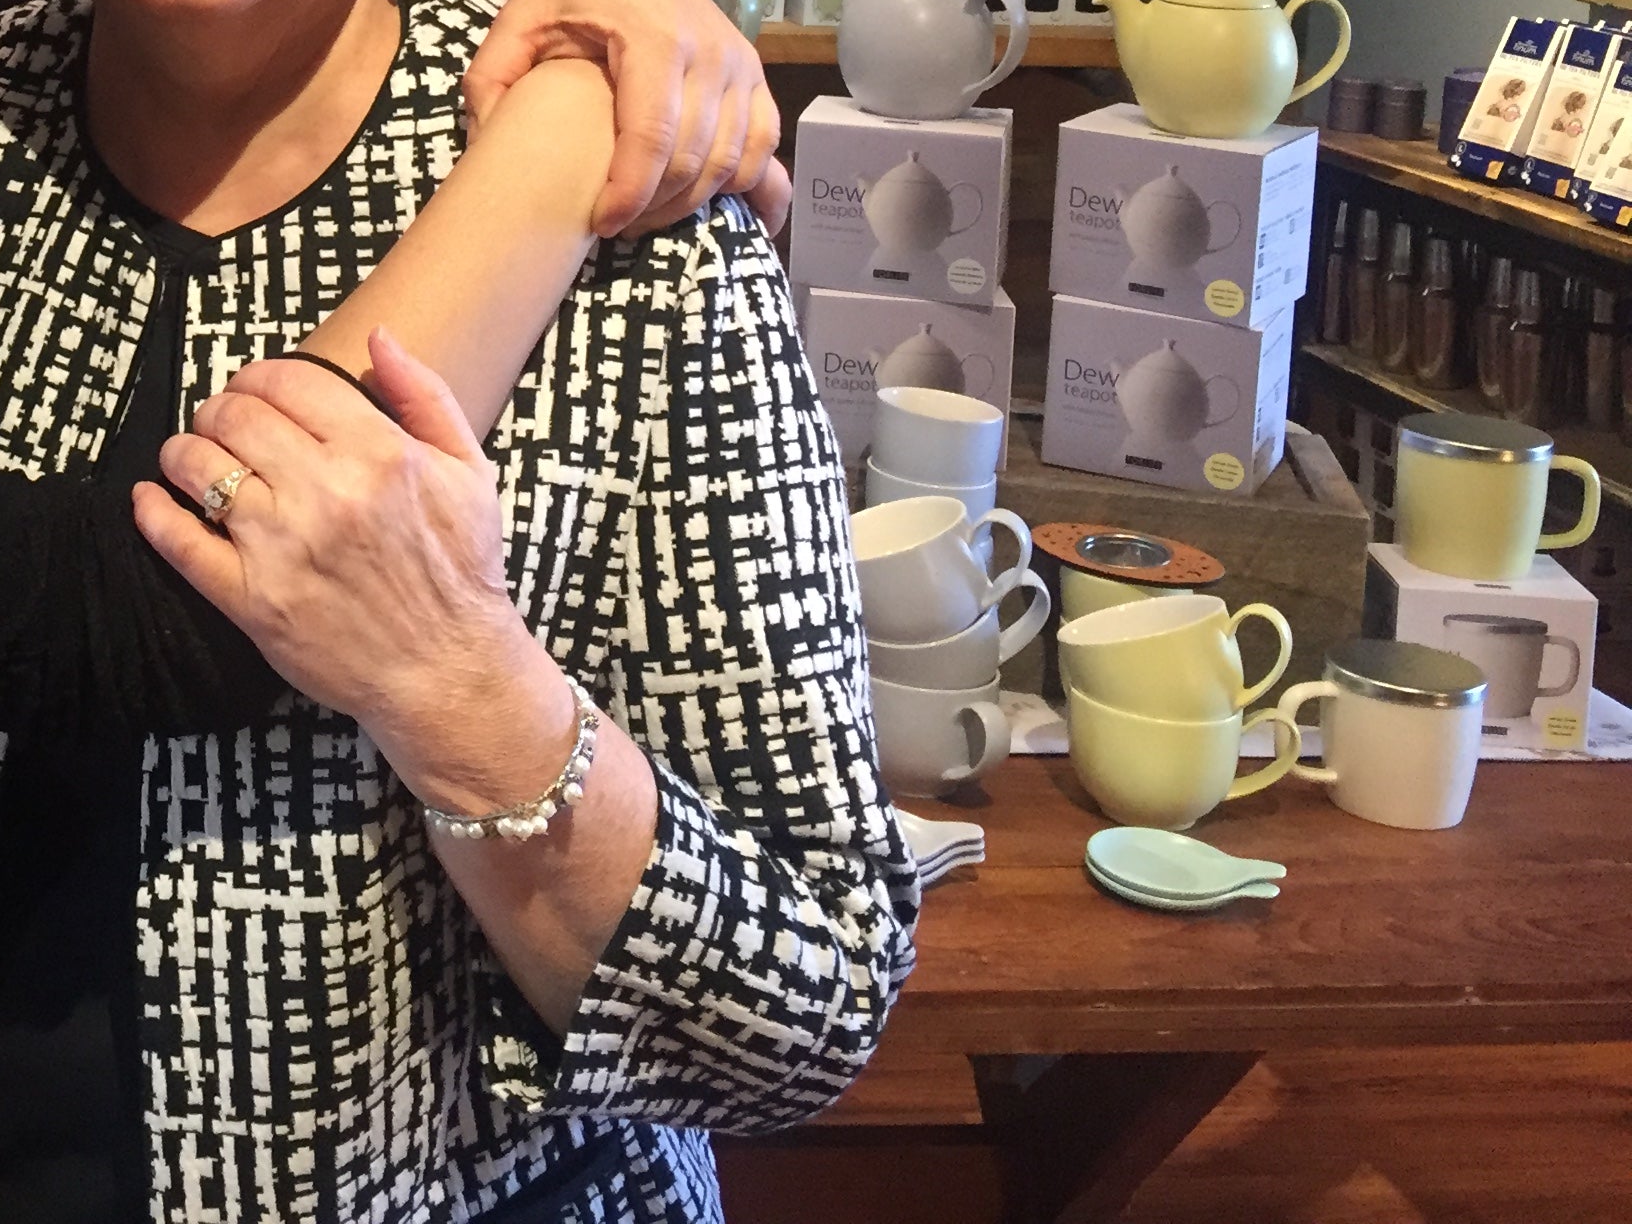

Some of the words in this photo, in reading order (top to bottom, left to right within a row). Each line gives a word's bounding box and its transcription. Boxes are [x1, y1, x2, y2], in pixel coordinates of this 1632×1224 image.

[811, 178, 866, 203] Dew
[1069, 186, 1124, 214] Dew
[812, 202, 866, 220] teapot
[824, 352, 879, 376] Dew
[1064, 358, 1120, 387] Dew
[824, 376, 878, 393] teapot
[1064, 383, 1118, 404] teapot
